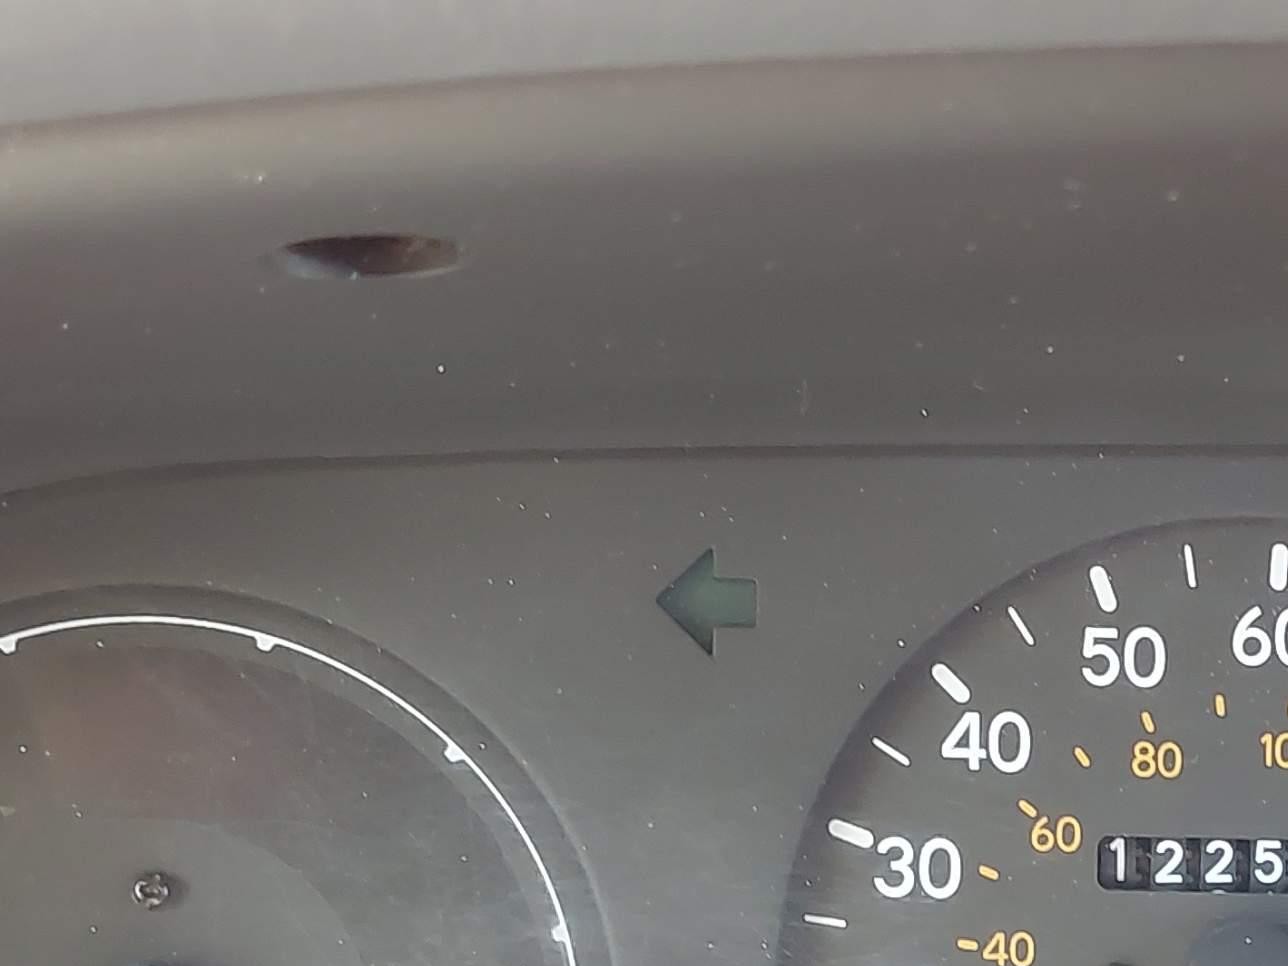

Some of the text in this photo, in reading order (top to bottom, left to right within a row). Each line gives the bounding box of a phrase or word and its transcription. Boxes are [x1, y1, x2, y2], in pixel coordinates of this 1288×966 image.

[1081, 626, 1166, 688] 50
[941, 711, 1031, 773] 40
[1130, 739, 1184, 780] 80
[1029, 815, 1083, 855] 60
[873, 836, 962, 900] 30
